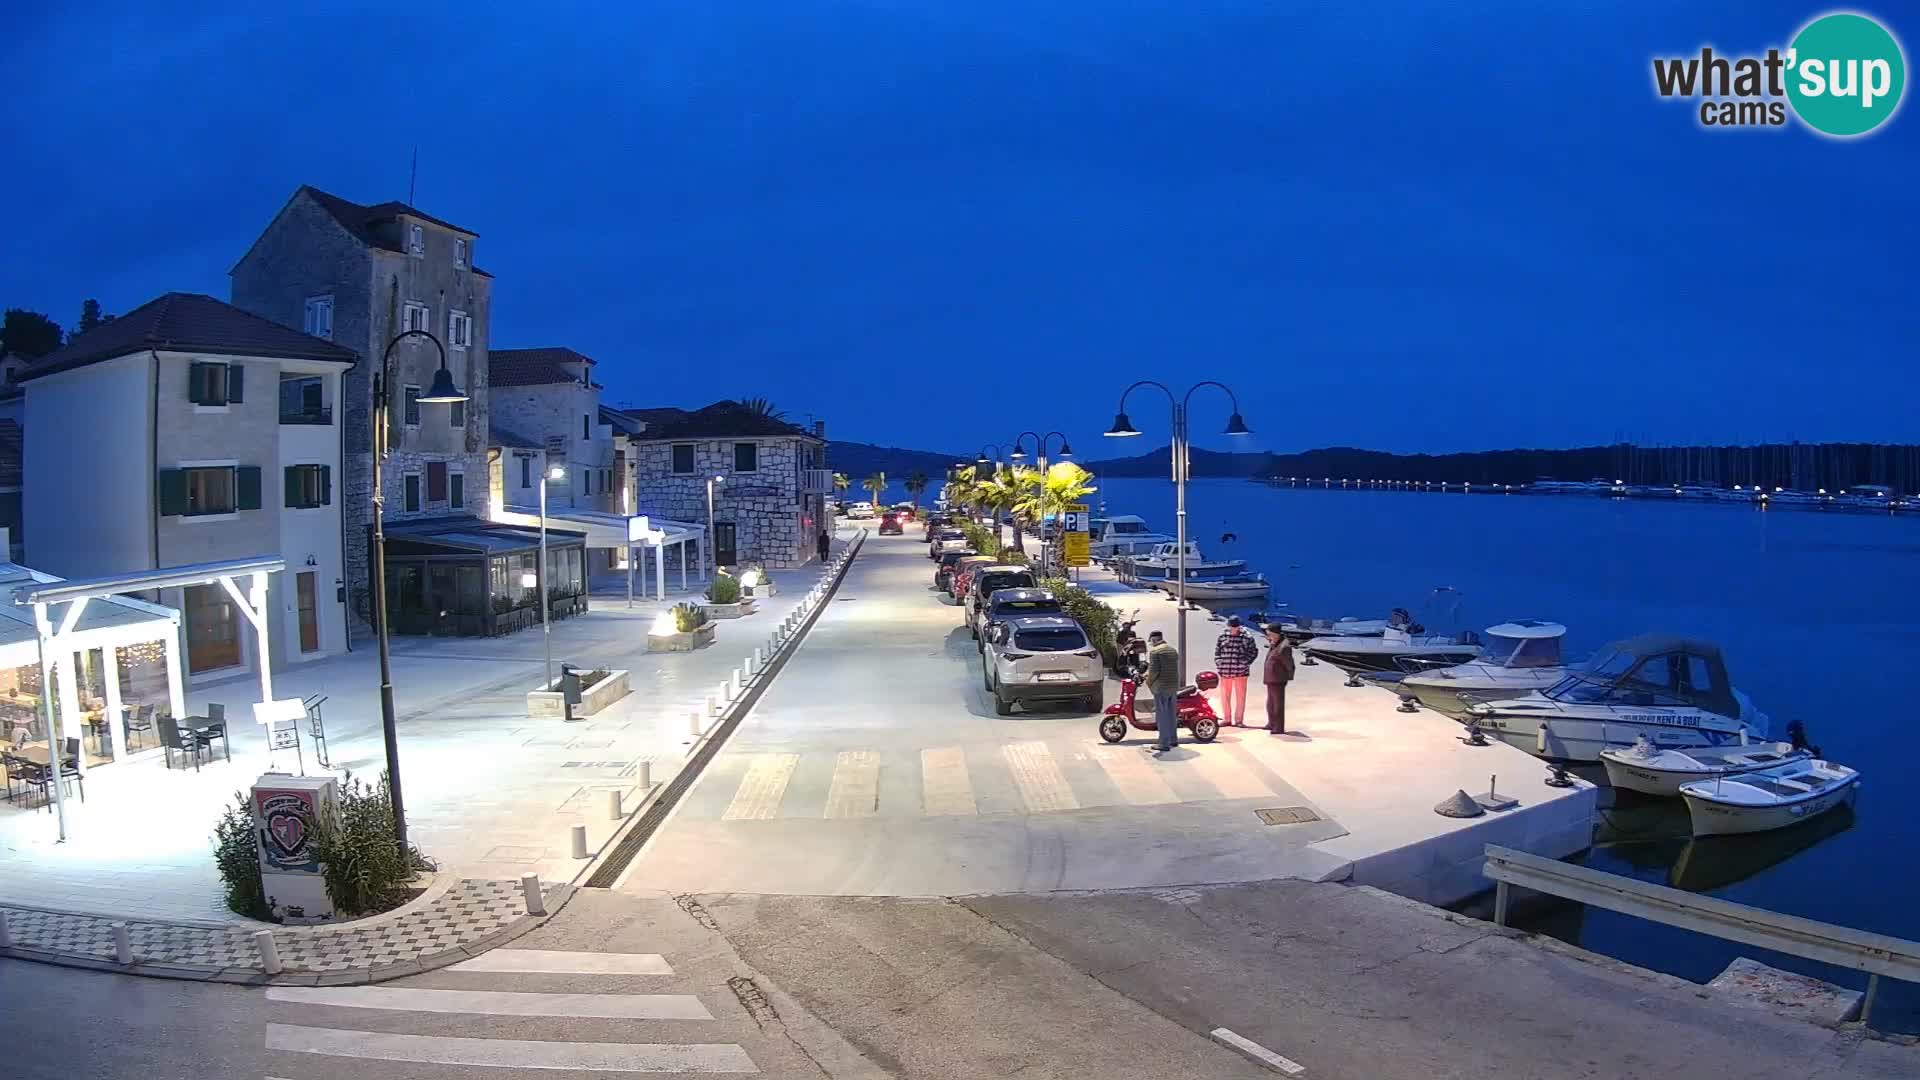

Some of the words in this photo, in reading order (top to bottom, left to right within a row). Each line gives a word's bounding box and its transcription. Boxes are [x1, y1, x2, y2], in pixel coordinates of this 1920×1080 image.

[1066, 514, 1077, 530] P
[1657, 715, 1676, 725] RENT
[1683, 716, 1701, 727] BOAT
